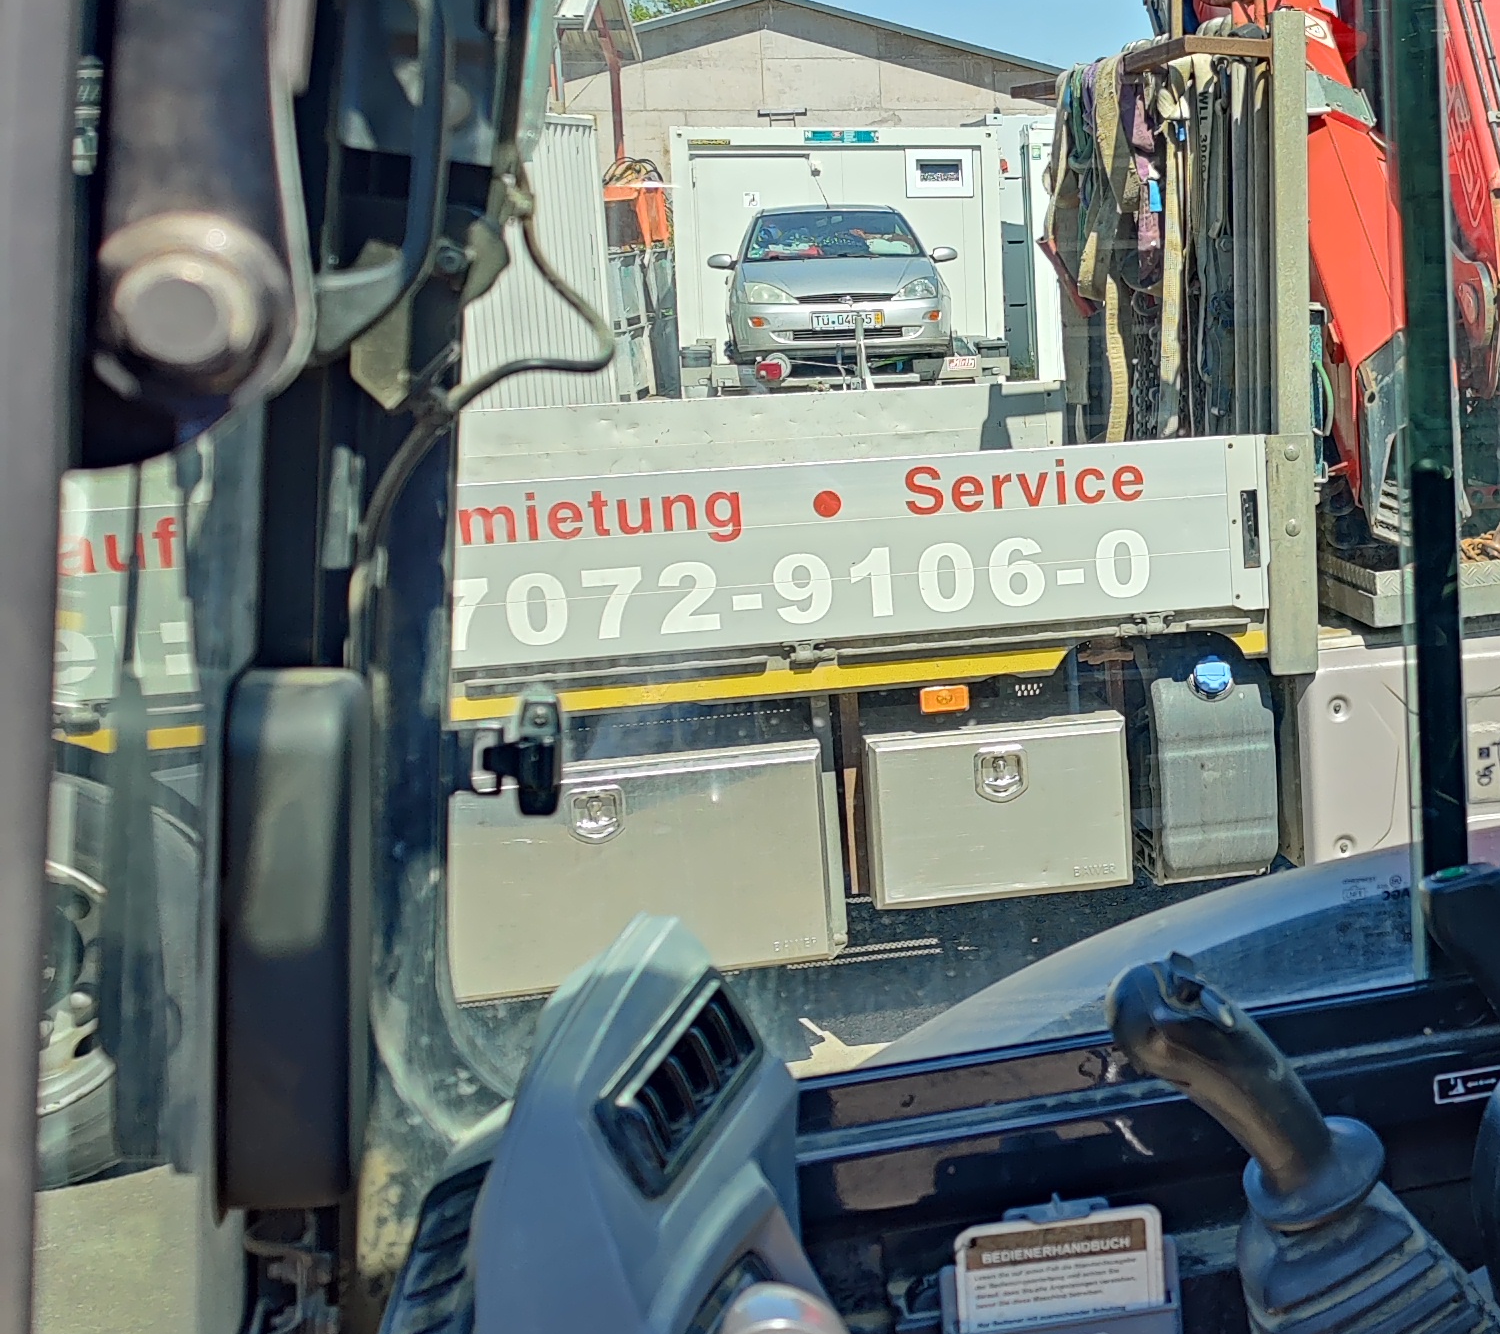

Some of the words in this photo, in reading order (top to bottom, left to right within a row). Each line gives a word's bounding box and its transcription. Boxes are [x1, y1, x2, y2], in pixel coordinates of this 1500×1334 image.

[1198, 91, 1209, 126] WLL
[458, 490, 743, 543] mietung
[904, 458, 1144, 515] Service
[453, 529, 1150, 652] 7072-9106-0
[1073, 863, 1116, 877] BAWER
[981, 1235, 1131, 1265] BEDIENERHANDBUCH
